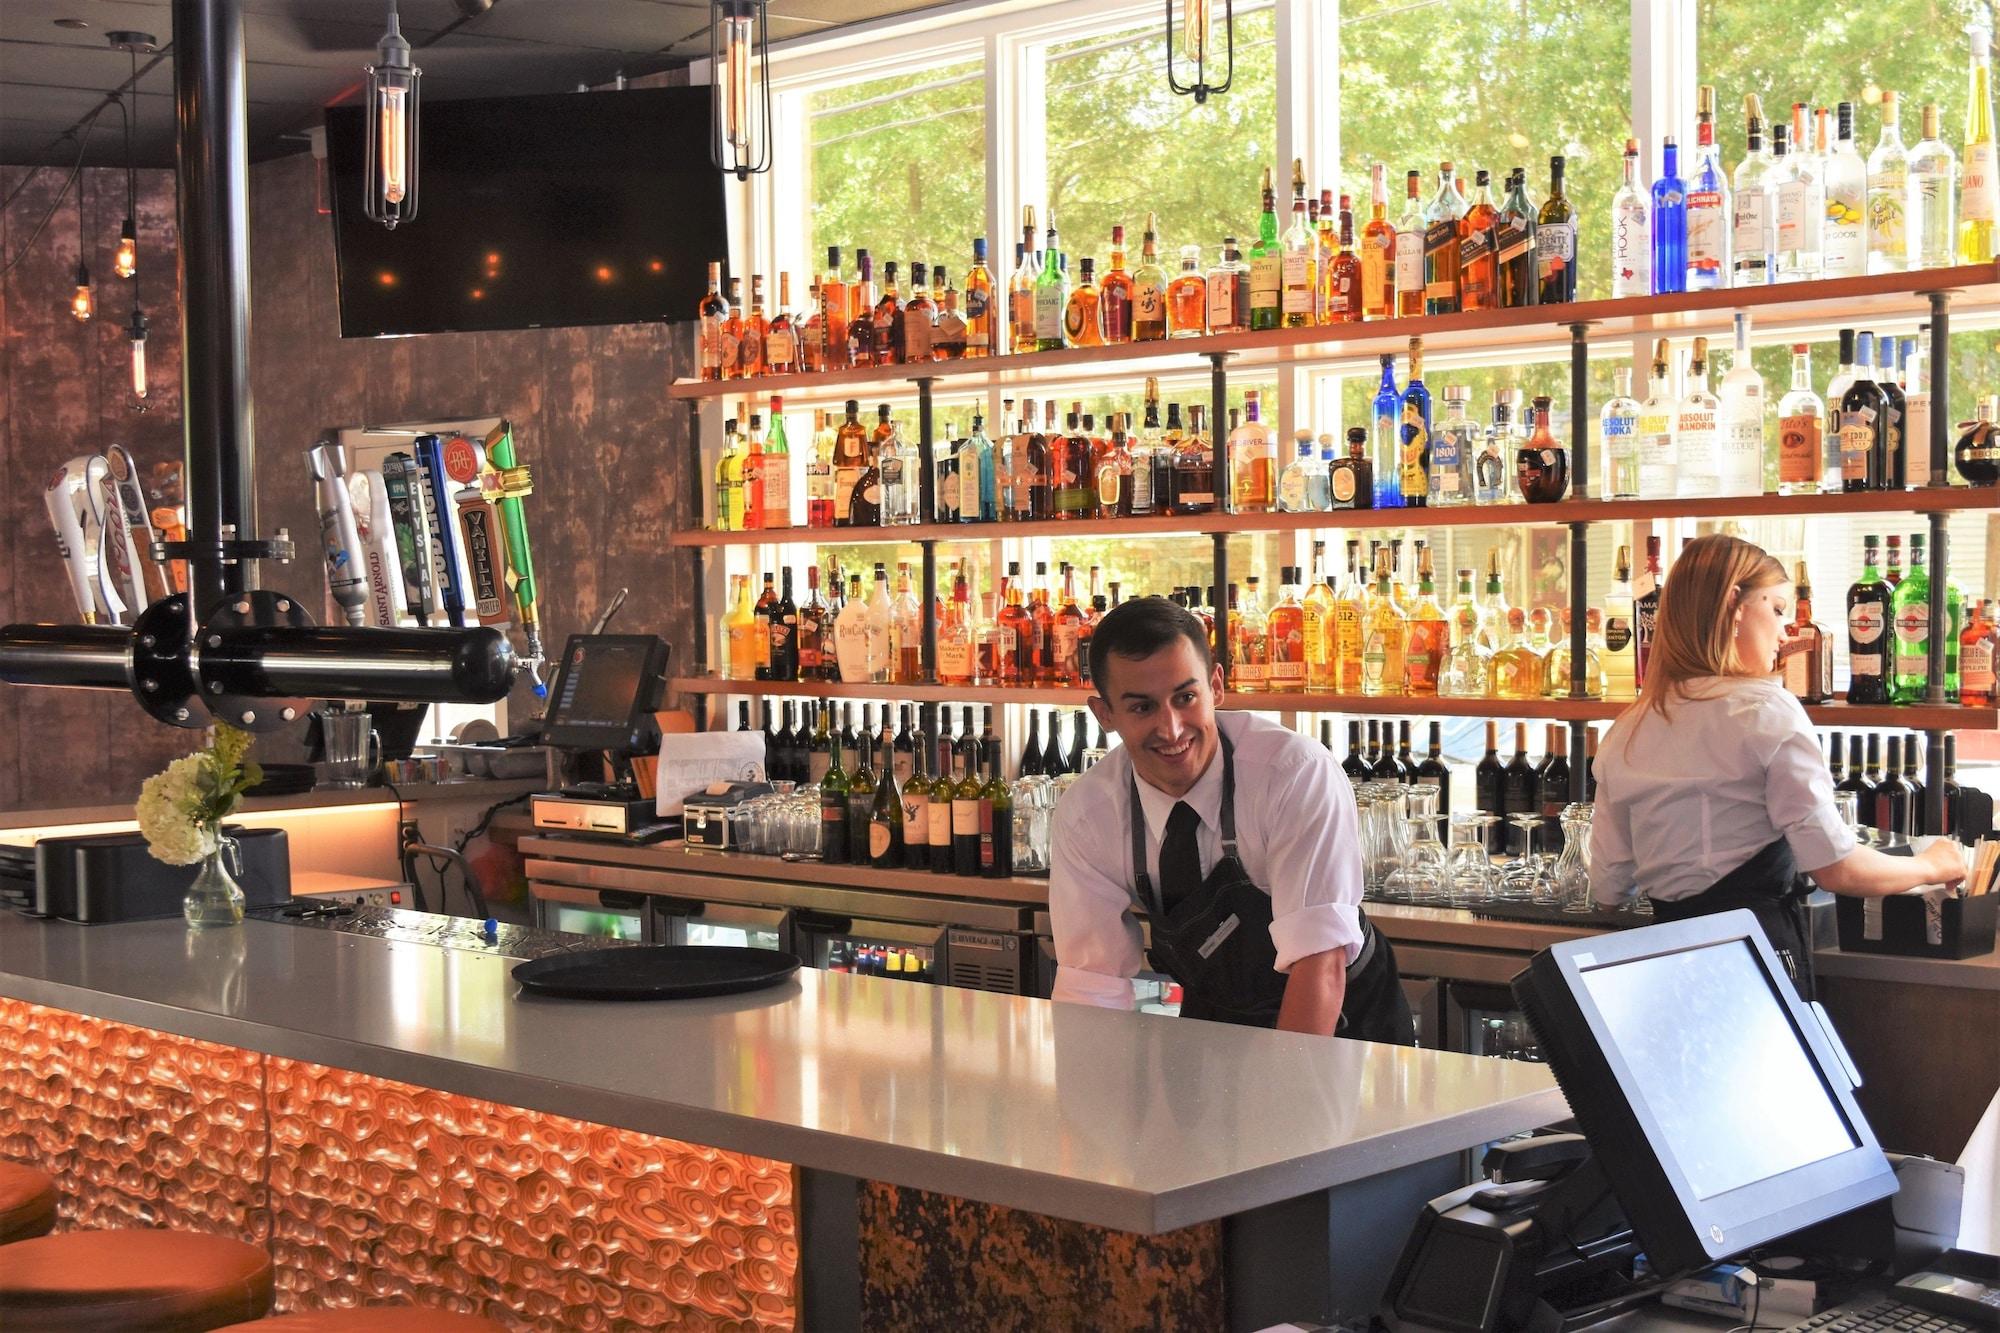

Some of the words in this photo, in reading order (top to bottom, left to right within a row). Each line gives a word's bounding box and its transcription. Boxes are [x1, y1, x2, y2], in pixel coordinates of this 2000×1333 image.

[1618, 216, 1628, 258] ROCK
[1602, 415, 1634, 426] ABSOLUT
[1679, 412, 1714, 422] ABSOLUT
[1604, 425, 1632, 436] VODKA
[1679, 421, 1716, 432] MANDRIN
[1850, 431, 1868, 440] EDDY
[1435, 446, 1456, 458] 1800
[392, 483, 406, 494] IPA
[416, 465, 441, 535] LIGHT
[409, 482, 432, 600] ELYSIAN
[467, 512, 495, 598] VANILLA
[431, 538, 450, 589] BUD
[369, 551, 388, 595] ARNOLD
[376, 594, 390, 626] SAINT
[478, 600, 500, 614] PORTER
